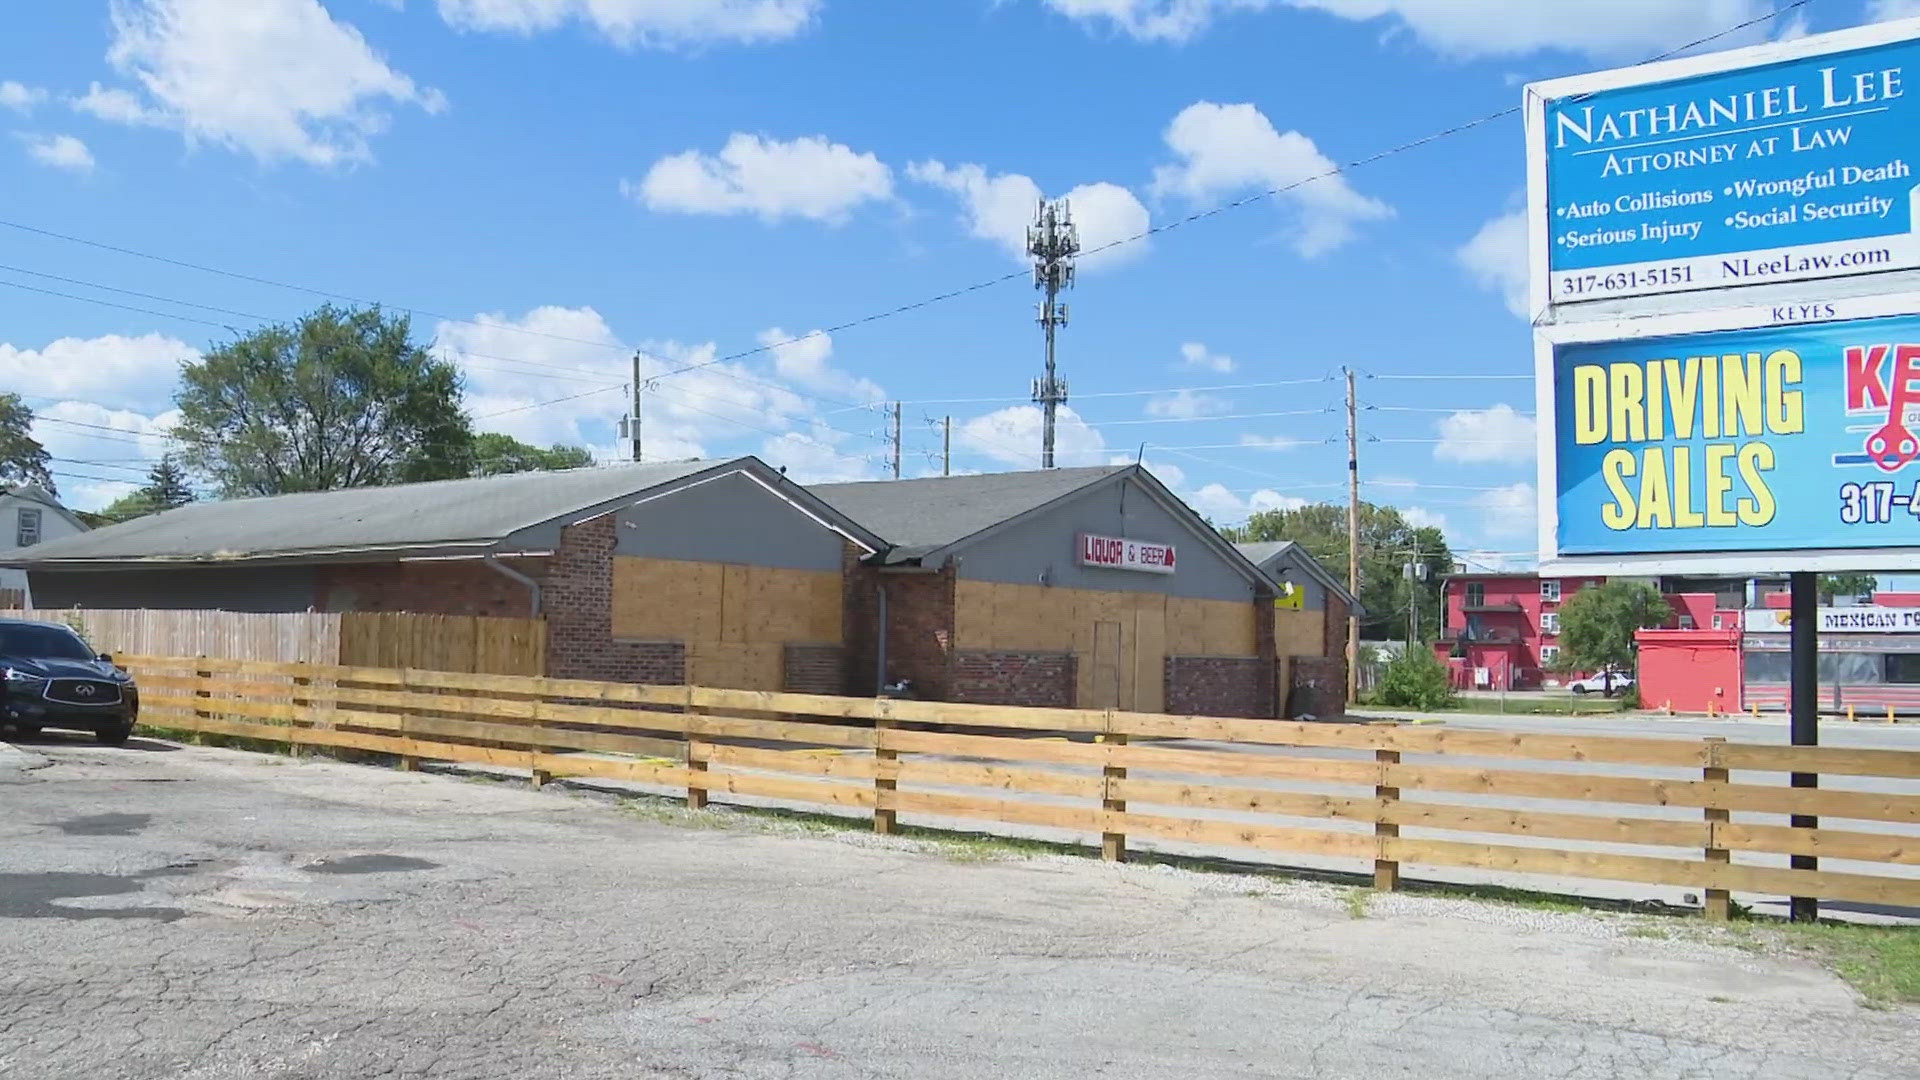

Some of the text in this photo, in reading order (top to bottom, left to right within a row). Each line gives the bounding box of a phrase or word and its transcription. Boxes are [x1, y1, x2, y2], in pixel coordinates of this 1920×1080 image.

[1555, 66, 1905, 149] NATHANIEL LEE
[1600, 126, 1852, 178] ATTORNEY AT LAW
[1842, 160, 1911, 187] Death
[1615, 188, 1714, 213] Collisions
[1803, 197, 1895, 226] Security
[1642, 220, 1702, 246] Injury
[1721, 248, 1891, 279] NLeeLaw.com
[1563, 265, 1693, 295] 317-631-5151
[1773, 304, 1836, 321] KEYES
[1845, 344, 1920, 412] KE
[1573, 350, 1804, 445] DRIVING
[1601, 441, 1777, 531] SALES
[1085, 537, 1164, 565] LIQUOR & BEER
[1825, 612, 1897, 629] MEXICAN
